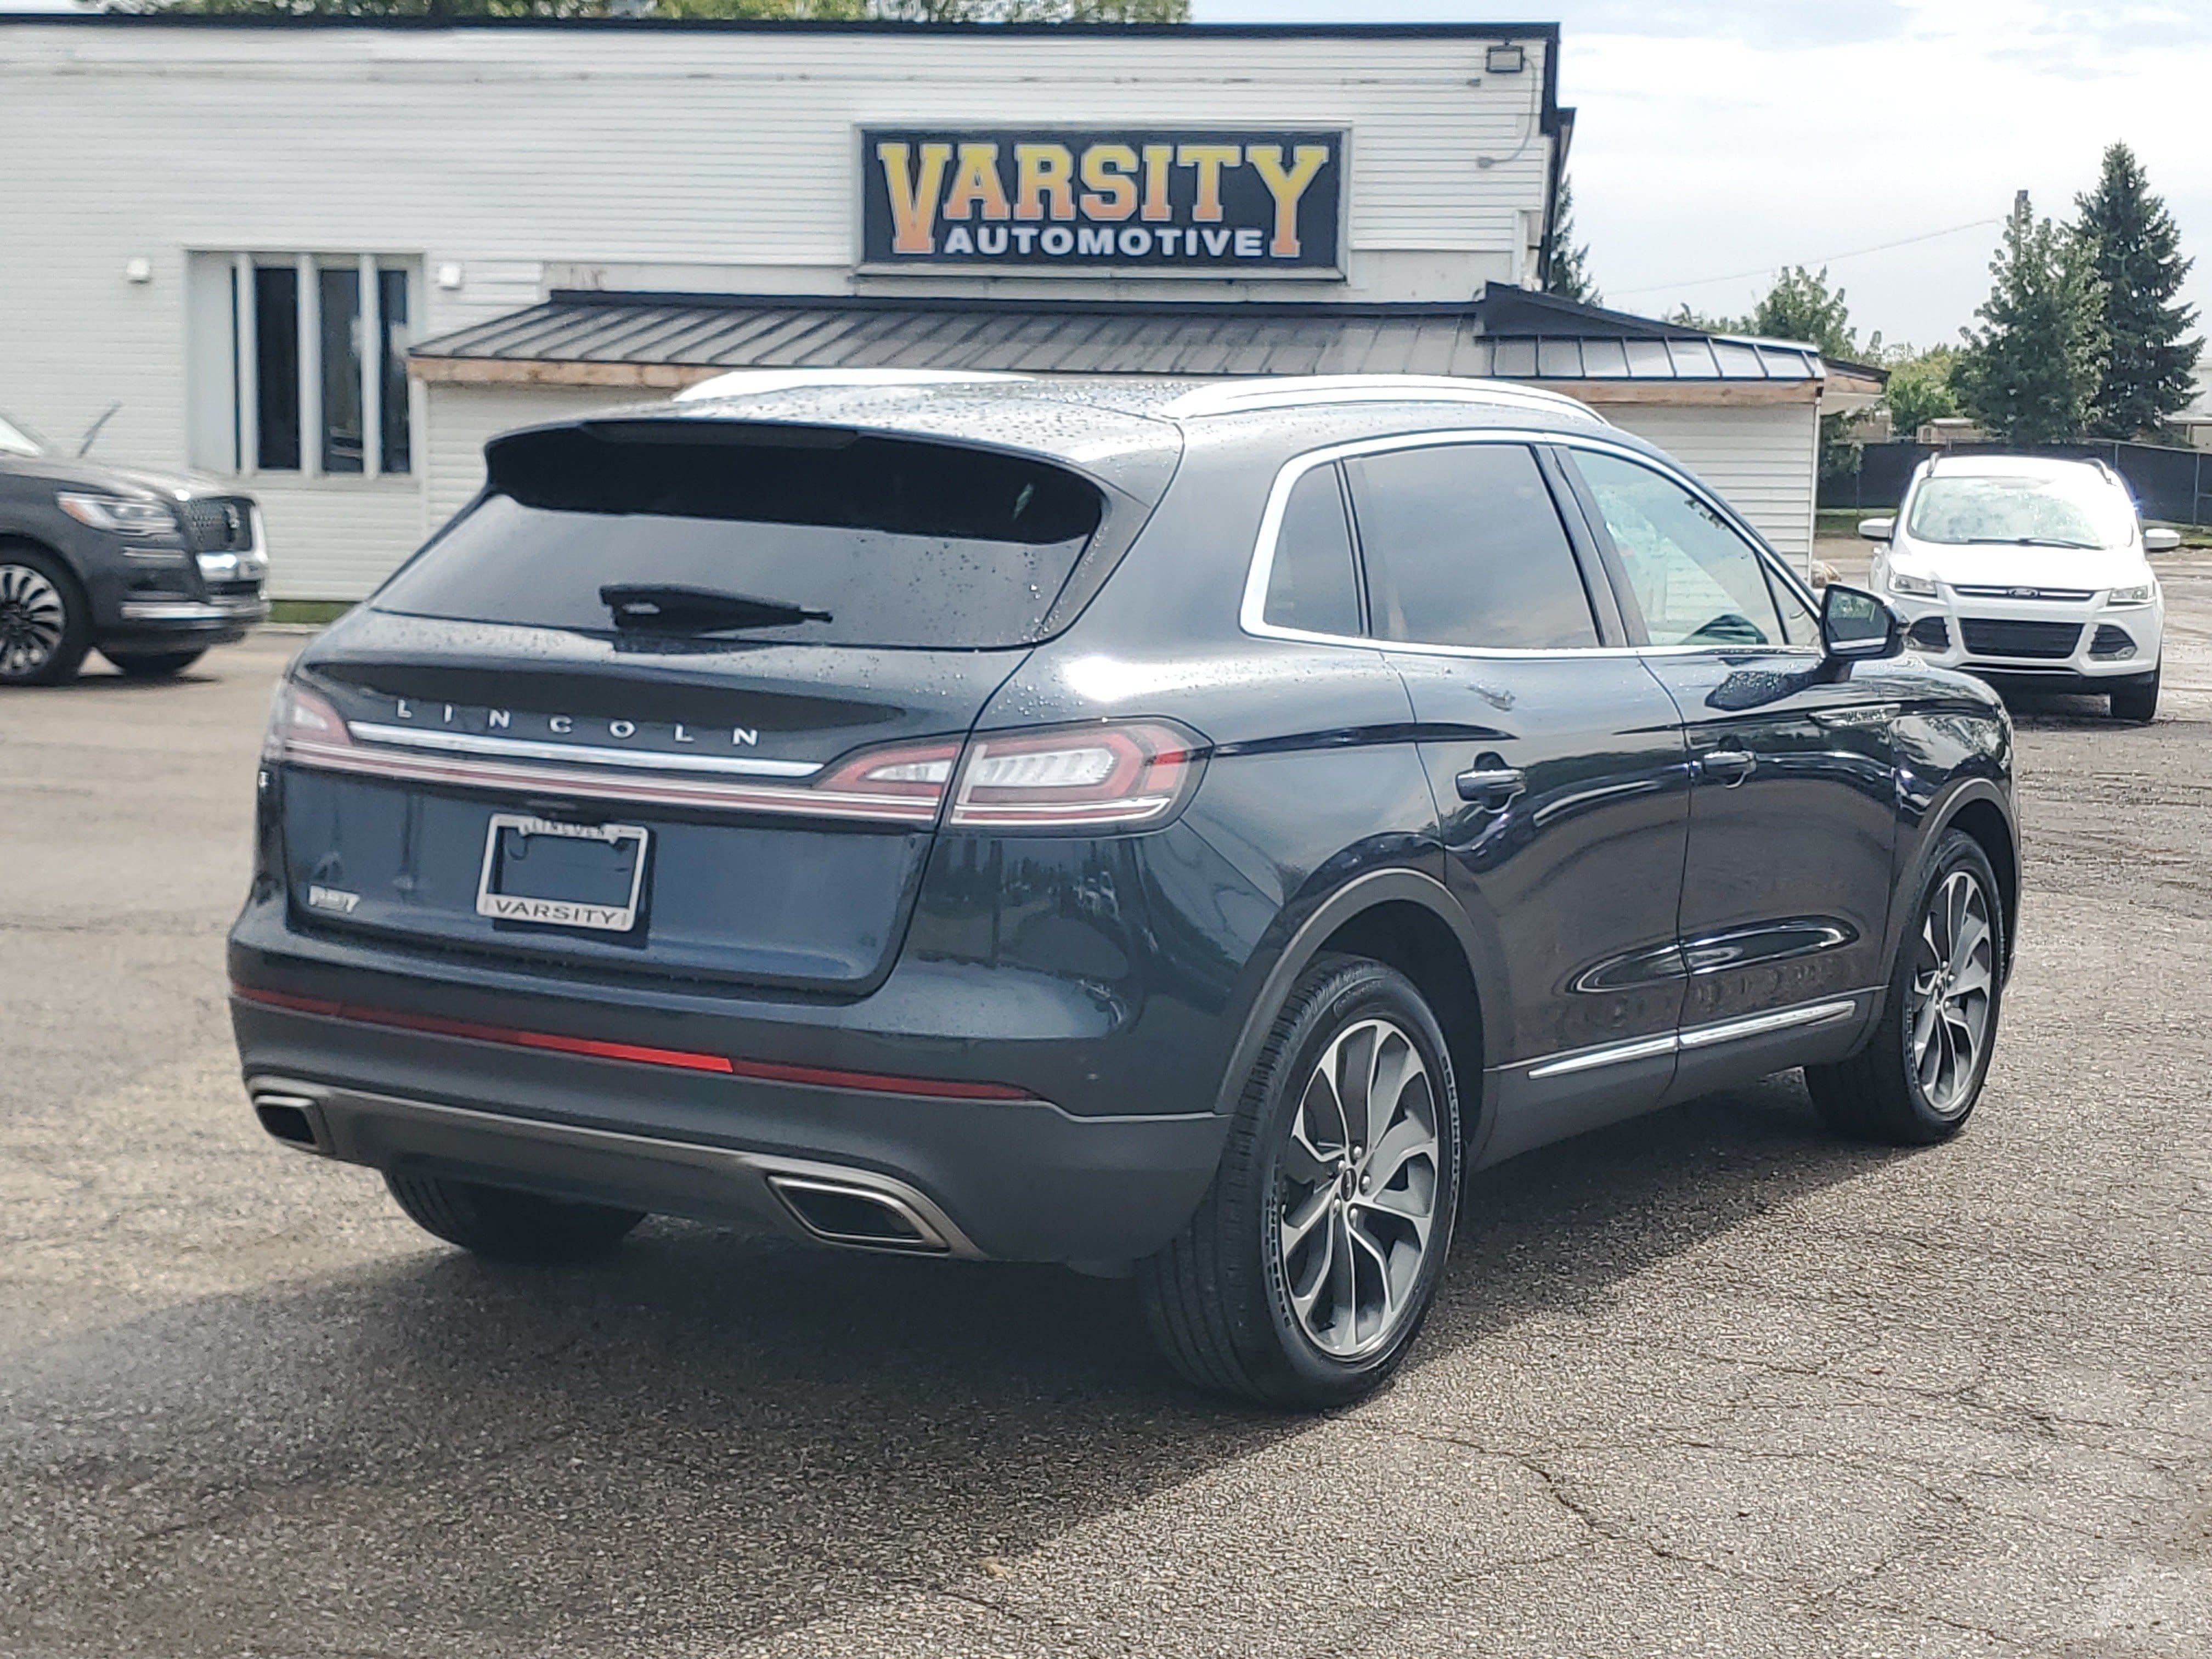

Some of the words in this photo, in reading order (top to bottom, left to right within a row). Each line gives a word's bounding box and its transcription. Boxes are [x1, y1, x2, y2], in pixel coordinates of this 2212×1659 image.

[878, 143, 1329, 257] VARSITY
[944, 227, 1263, 257] AUTOMOTIVE
[397, 699, 758, 746] LINCOLN
[495, 900, 617, 925] VARSITY
